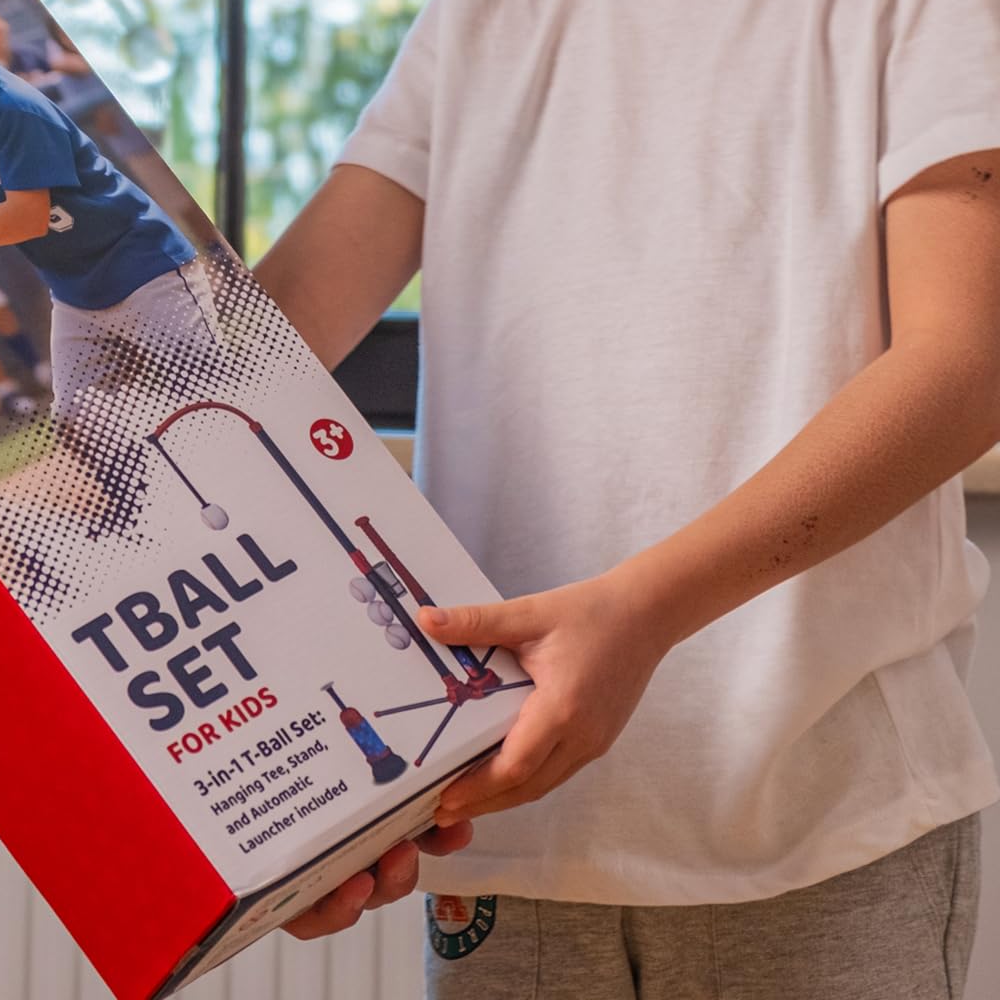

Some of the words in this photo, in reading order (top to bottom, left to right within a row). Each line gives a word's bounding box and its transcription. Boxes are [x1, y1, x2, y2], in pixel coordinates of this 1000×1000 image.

[312, 422, 344, 457] 3+
[70, 533, 298, 673] TBALL
[127, 620, 259, 732] SET
[166, 722, 221, 764] FOR
[217, 686, 279, 733] KIDS
[193, 757, 245, 797] 3-in-1
[239, 727, 293, 768] T-Ball
[288, 709, 327, 739] Set:
[209, 777, 266, 817] Hanging
[260, 763, 292, 785] Tee,
[286, 739, 329, 769] Stand,
[225, 812, 252, 836] and
[251, 773, 314, 821] Automatic
[237, 810, 298, 855] Launcher
[293, 778, 349, 820] included
